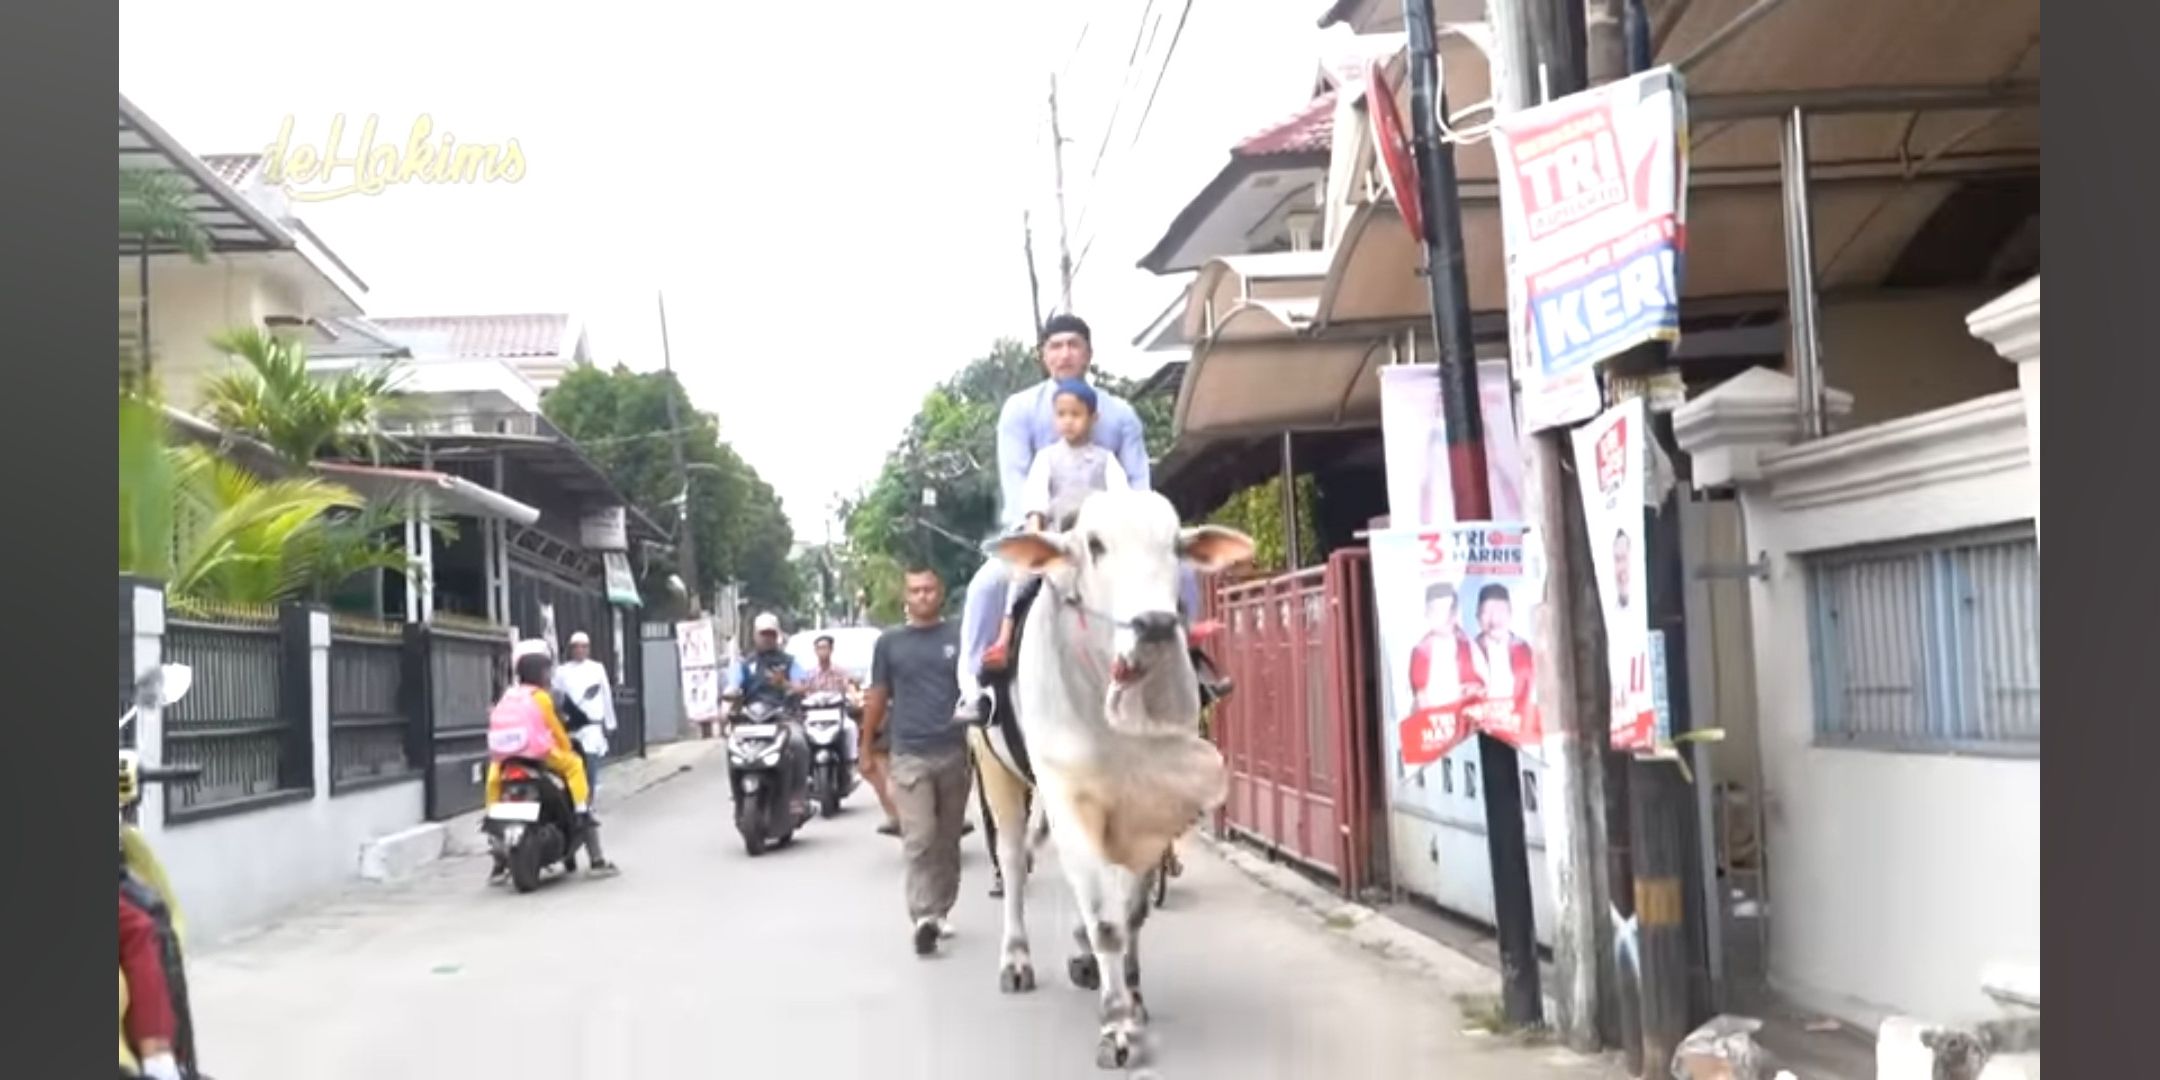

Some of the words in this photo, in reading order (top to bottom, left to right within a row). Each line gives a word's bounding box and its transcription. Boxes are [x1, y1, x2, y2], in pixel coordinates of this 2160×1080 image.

[1519, 130, 1619, 209] TRI
[1417, 532, 1443, 565] 3
[1452, 530, 1485, 547] TRI
[1452, 548, 1522, 563] HARRIS
